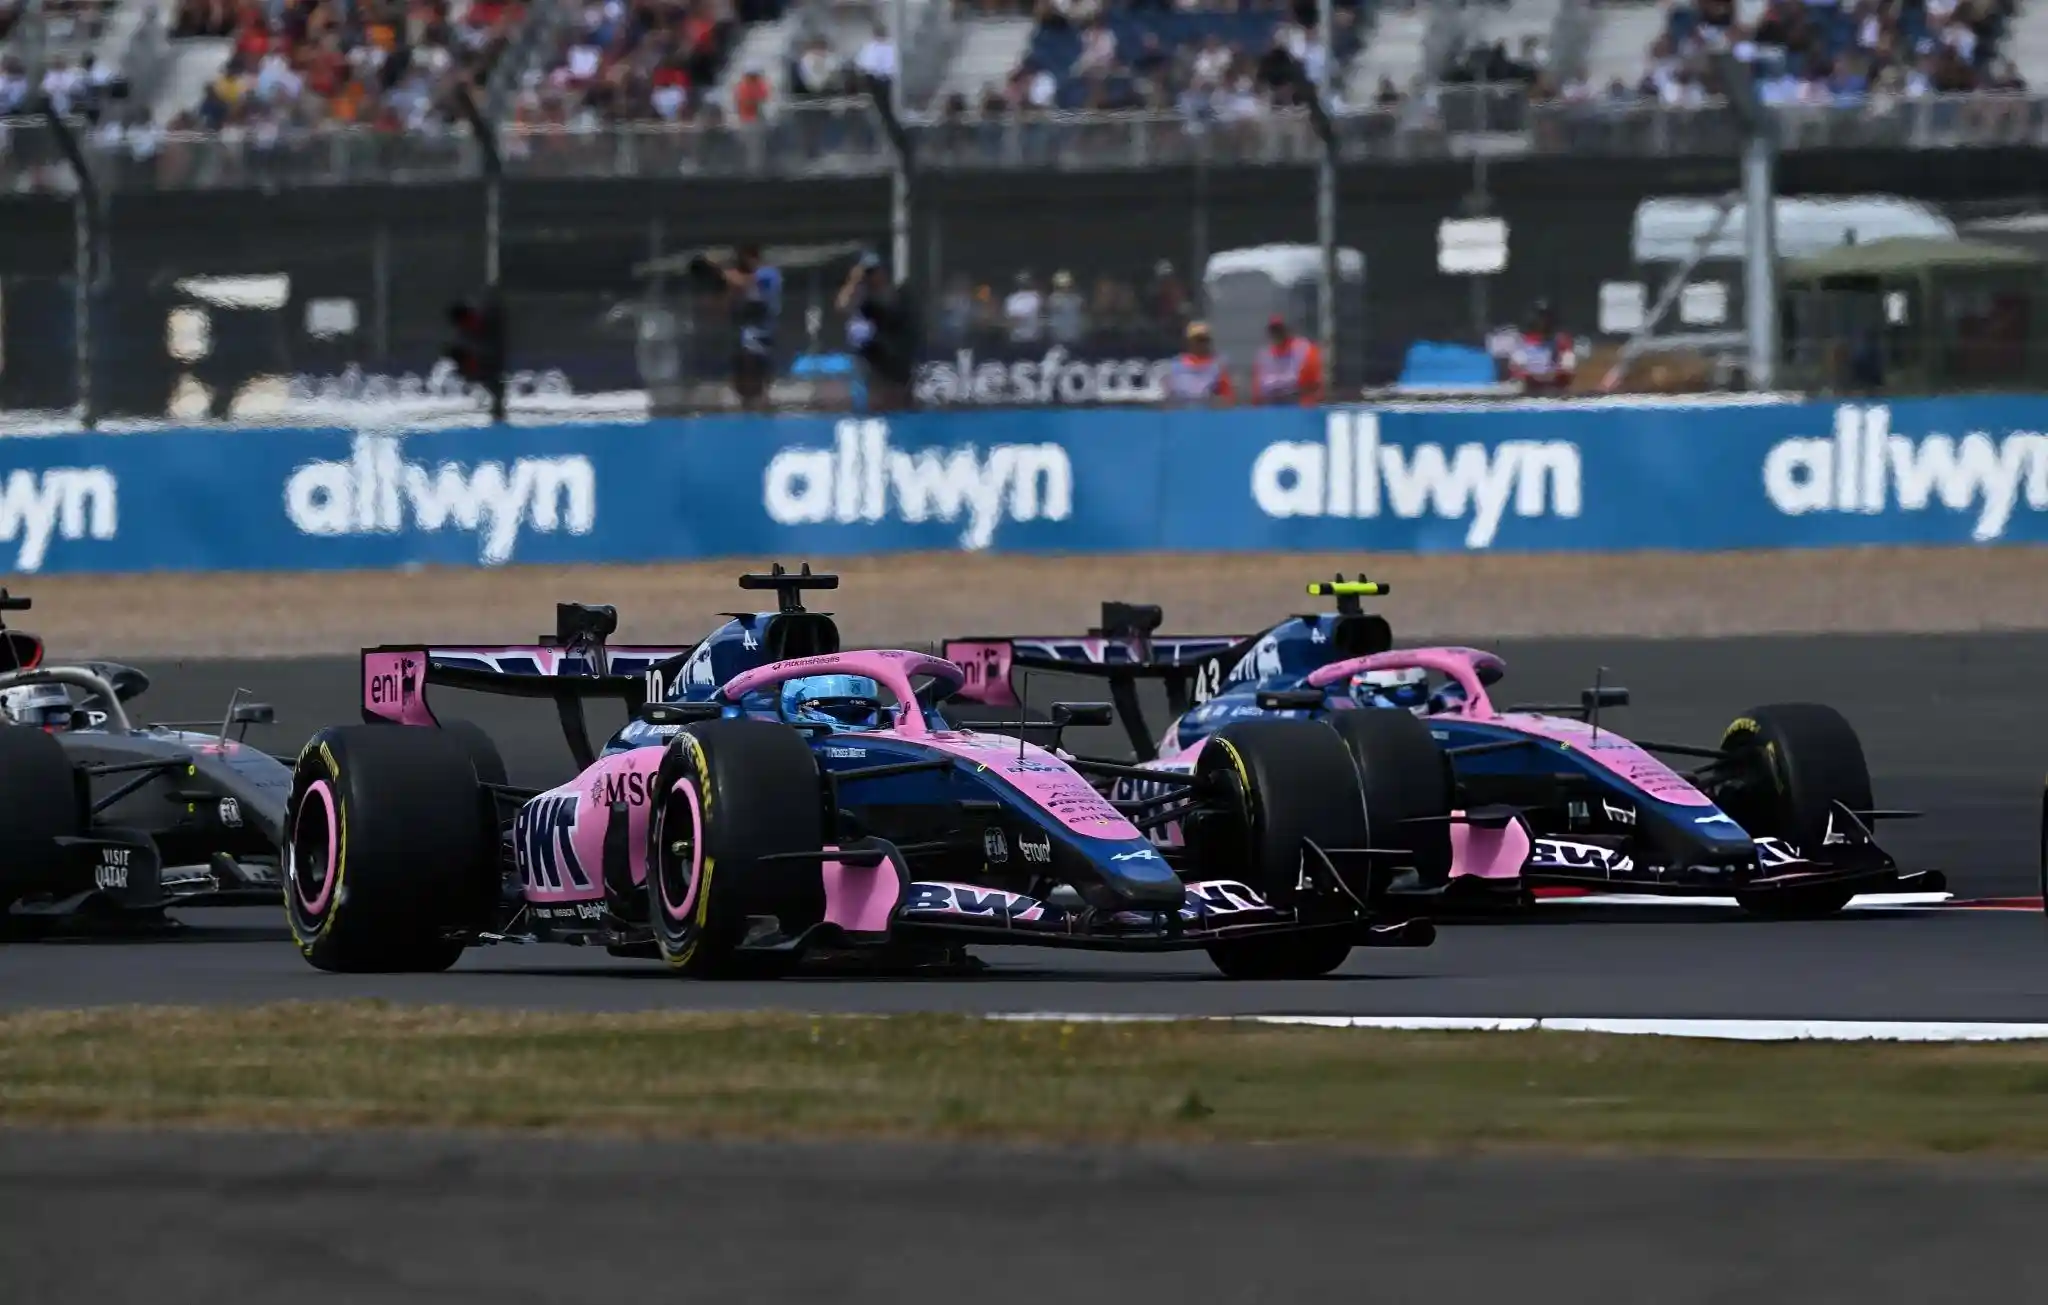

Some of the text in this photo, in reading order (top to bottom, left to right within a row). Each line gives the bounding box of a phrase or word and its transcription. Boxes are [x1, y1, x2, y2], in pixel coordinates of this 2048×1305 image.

[286, 432, 595, 564] allwyn
[764, 419, 1071, 550] allwyn
[1251, 411, 1581, 548] allwyn
[372, 662, 399, 703] eni
[645, 669, 663, 703] 10
[1195, 657, 1221, 705] 43
[95, 864, 129, 890] QATAR
[103, 850, 131, 865] VISIT
